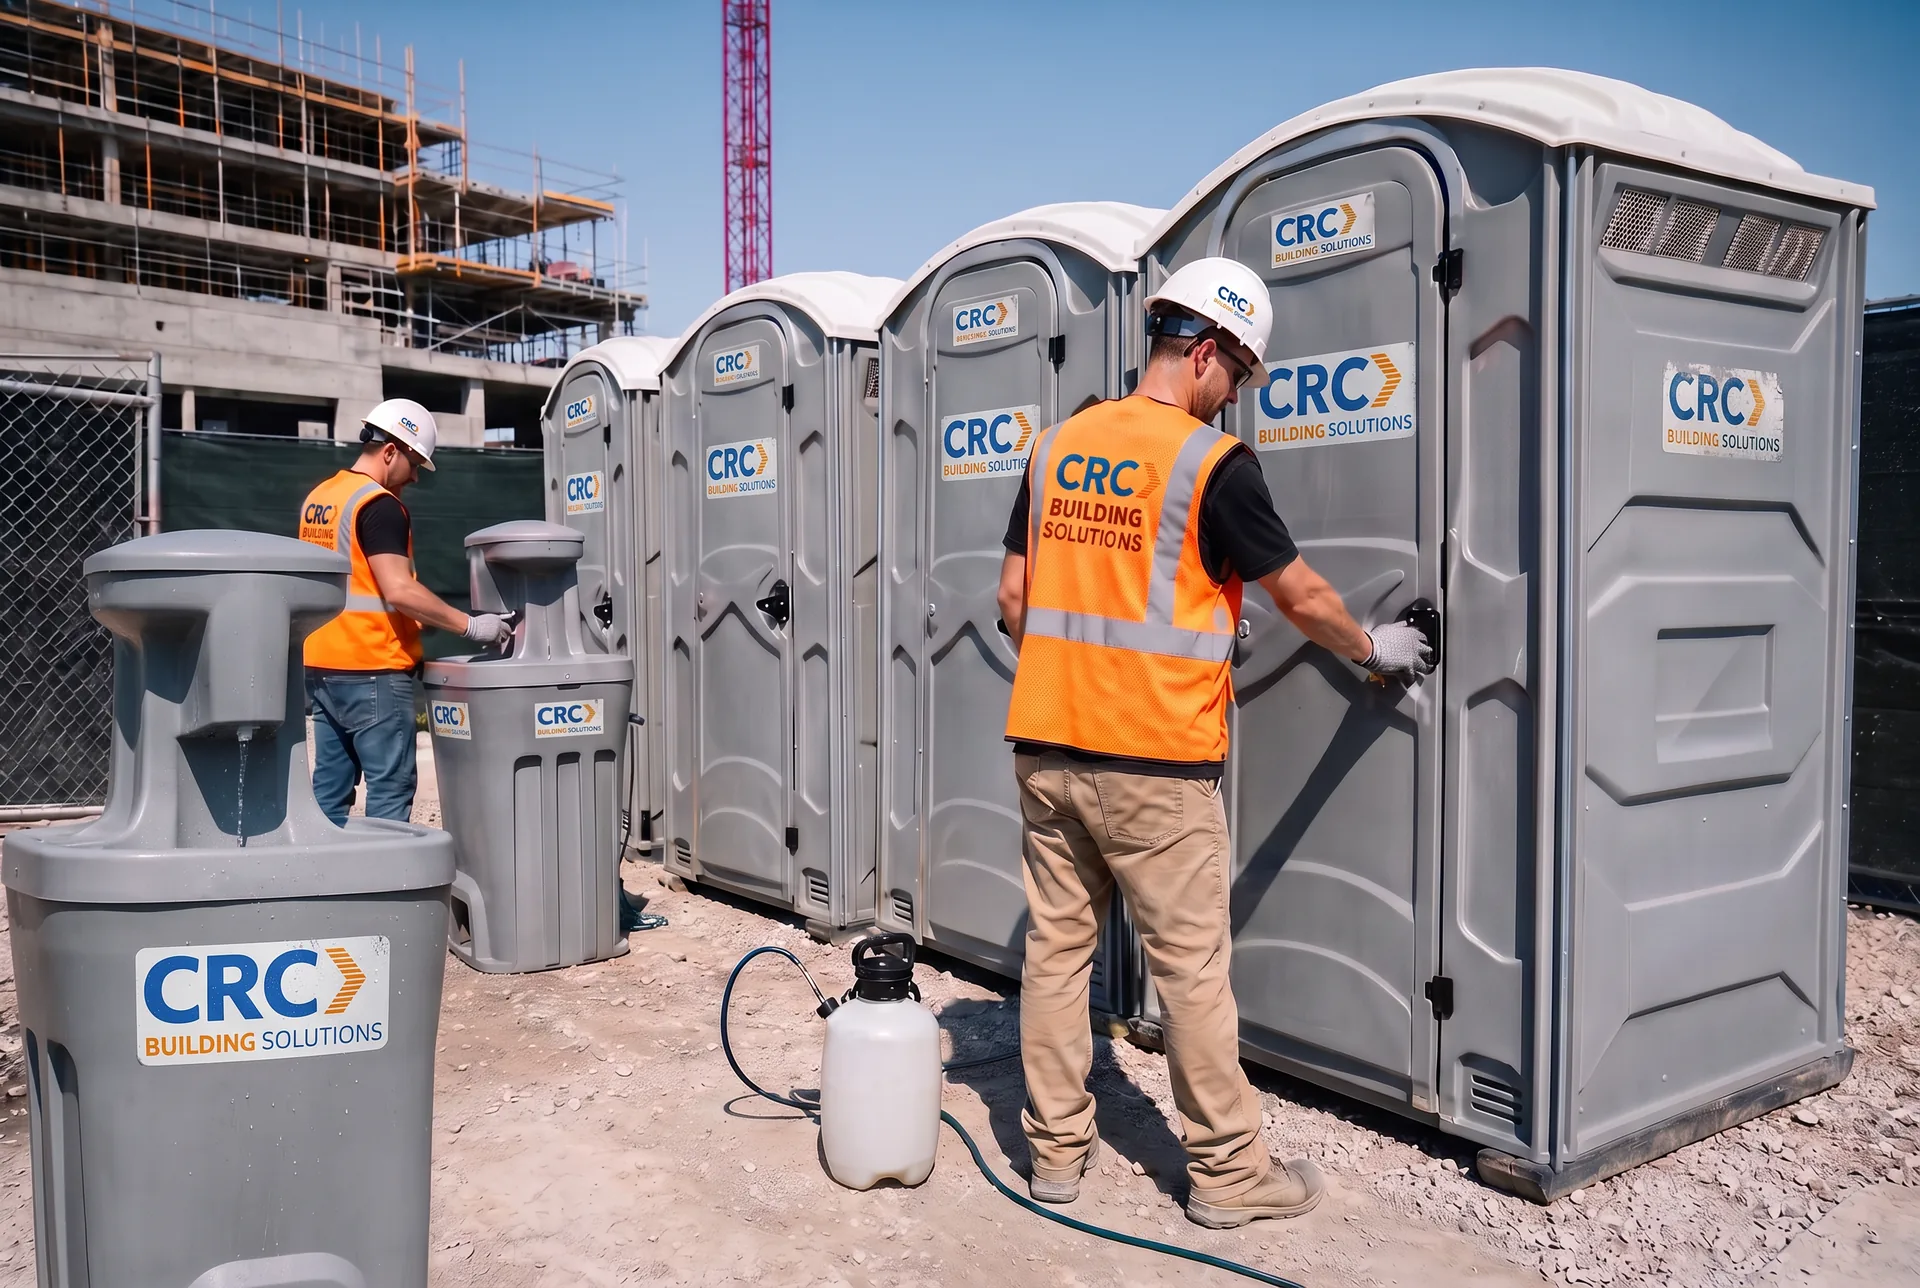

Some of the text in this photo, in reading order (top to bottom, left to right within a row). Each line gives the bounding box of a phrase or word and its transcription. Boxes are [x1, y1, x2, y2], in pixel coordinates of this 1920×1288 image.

[1275, 208, 1338, 247] CRC
[1275, 234, 1372, 263] BUILDING SOLUTIONS
[1218, 286, 1248, 312] CRC
[956, 304, 996, 331] CRC
[988, 326, 1016, 337] SOLUTIONS
[716, 352, 744, 374] CRC
[1259, 356, 1370, 420] CRC
[1669, 371, 1745, 426] CRC
[567, 400, 587, 419] CRC
[401, 417, 416, 432] CRC
[944, 414, 1013, 458] CRC
[1259, 414, 1413, 444] BUILDING SOLUTIONS
[1667, 429, 1780, 452] BUILDING SOLUTIONS
[708, 445, 755, 480] CRC
[944, 458, 1028, 476] BUILDING SOLUTIO
[1056, 453, 1140, 497] CRC
[568, 475, 593, 501] CRC
[708, 479, 776, 495] BUILDING SOLUTIONS
[305, 503, 332, 525] CRC
[1049, 498, 1142, 528] BUILDING
[1043, 521, 1142, 552] SOLUTIONS
[434, 705, 459, 726] CRC
[537, 704, 583, 725] CRC
[537, 725, 602, 736] BUILDING SOLUTIONS
[143, 949, 318, 1025] CRC
[145, 1022, 382, 1057] BUILDING SOLUTIONS
